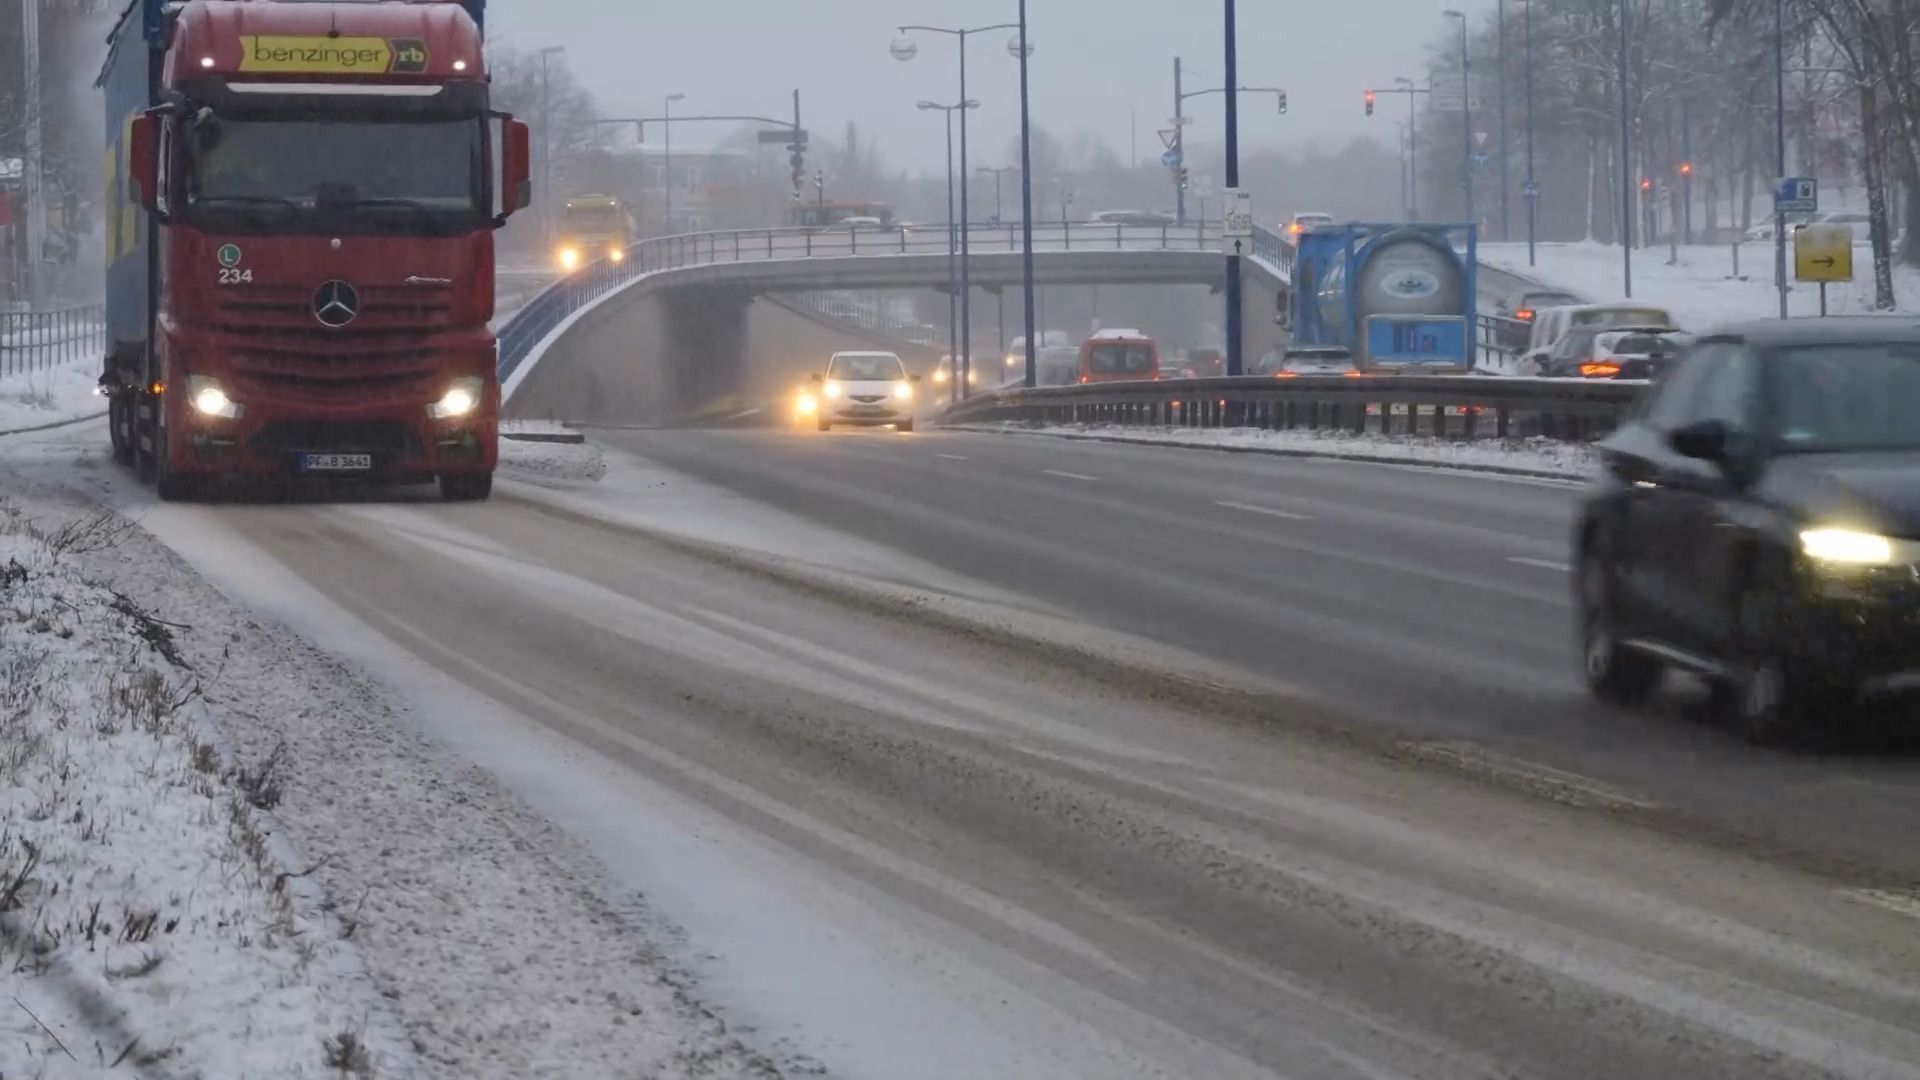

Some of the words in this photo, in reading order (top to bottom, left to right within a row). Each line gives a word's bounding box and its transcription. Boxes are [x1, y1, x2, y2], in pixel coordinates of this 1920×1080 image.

[254, 35, 382, 67] benzinger
[398, 47, 425, 63] rb
[218, 268, 254, 284] 234
